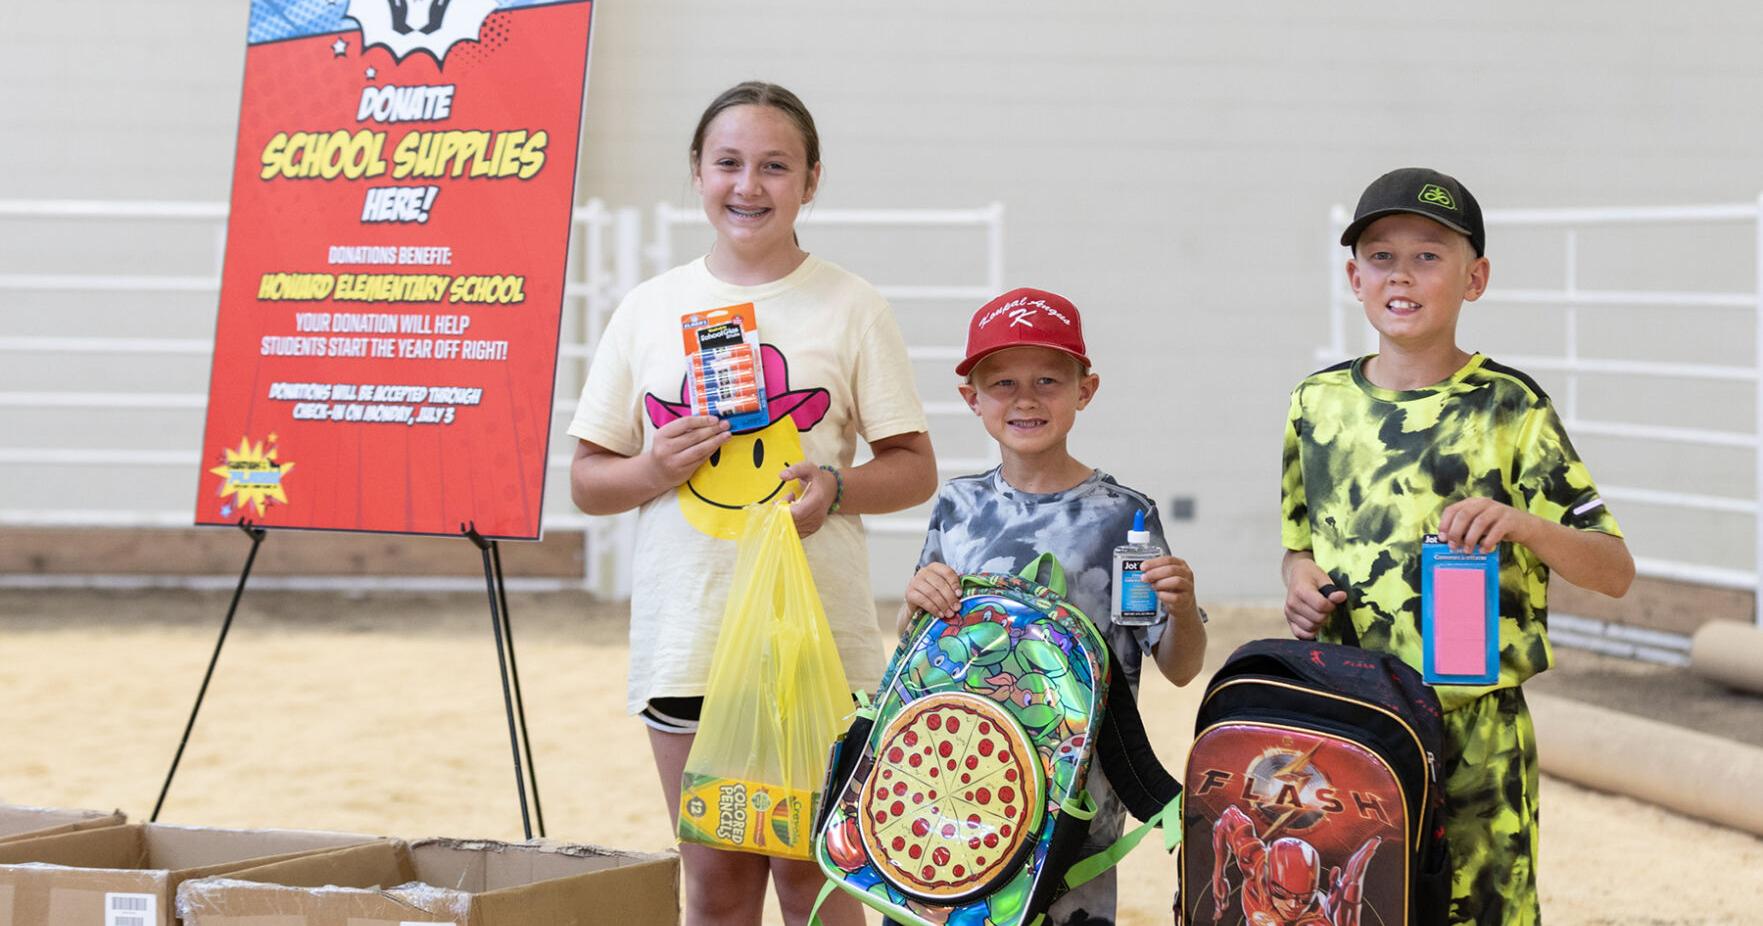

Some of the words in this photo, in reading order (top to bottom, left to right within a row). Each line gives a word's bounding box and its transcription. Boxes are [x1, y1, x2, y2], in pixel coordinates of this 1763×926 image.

[357, 84, 456, 123] DONATE
[260, 129, 388, 180] SCHOOL
[392, 129, 549, 180] SUPPLIES
[360, 186, 440, 224] HERE!
[328, 246, 397, 265] DONATIONS
[398, 247, 453, 266] BENEFIT:
[256, 272, 335, 302] HOWARD
[333, 273, 451, 304] ELEMENTARY
[449, 275, 526, 304] SCHOOL
[295, 312, 331, 332] YOUR
[332, 313, 398, 334] DONATION
[400, 314, 433, 334] WILL
[433, 315, 471, 336] HELP
[1008, 308, 1038, 328] K
[1027, 300, 1070, 325] Angus
[260, 335, 327, 357] STUDENTS
[327, 337, 368, 358] START
[370, 338, 396, 358] THE
[397, 338, 433, 359] YEAR
[434, 339, 461, 360] OFF
[461, 340, 509, 361] RIGHT!
[330, 384, 358, 402] WILL
[357, 385, 376, 402] BE
[373, 385, 429, 404] ACCEPTED
[428, 387, 483, 406] THROUGH
[1125, 562, 1137, 570] Jot
[690, 799, 703, 815] 12
[1195, 768, 1393, 828] FLASH
[716, 785, 734, 840] PENCILS
[730, 784, 747, 844] COLORED
